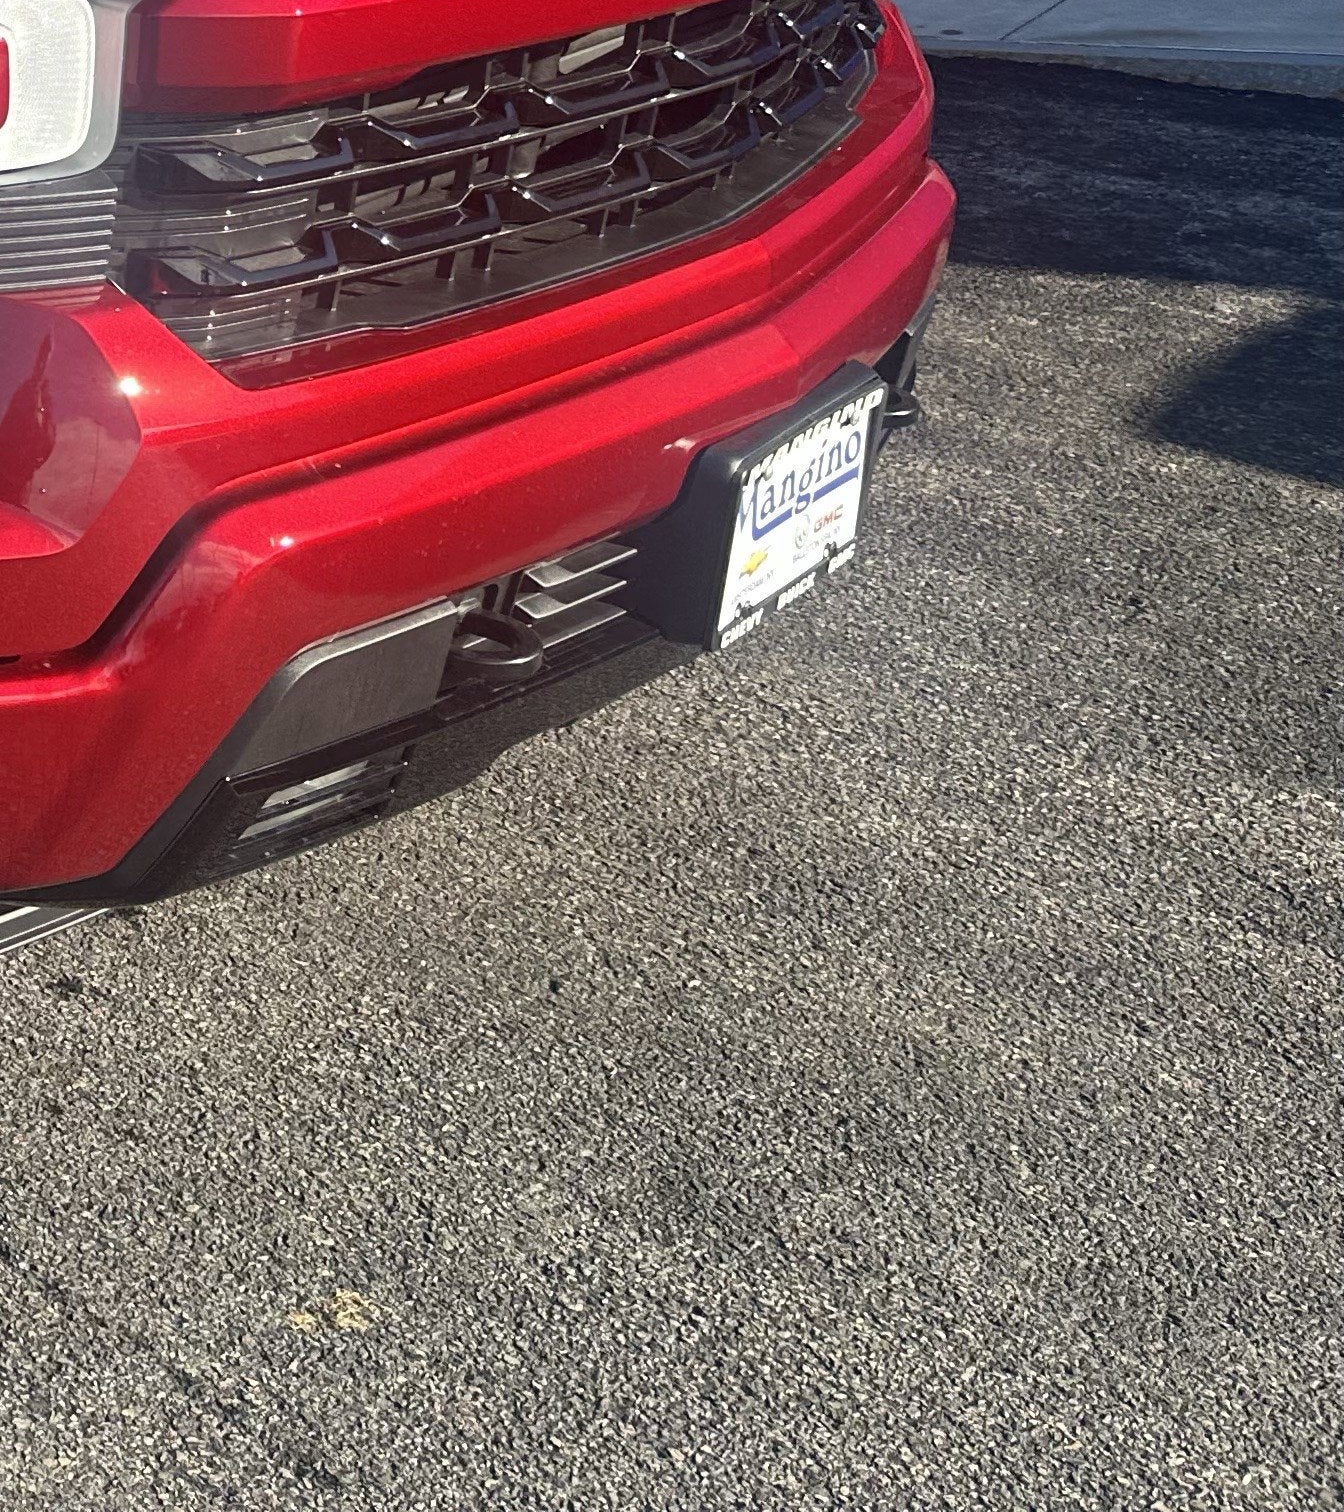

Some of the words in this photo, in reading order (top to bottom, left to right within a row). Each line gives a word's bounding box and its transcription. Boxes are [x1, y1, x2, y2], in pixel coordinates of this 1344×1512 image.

[737, 431, 863, 541] Mangino
[813, 504, 844, 533] GMC
[720, 608, 764, 649] CHEVY
[777, 572, 816, 611] BUICK
